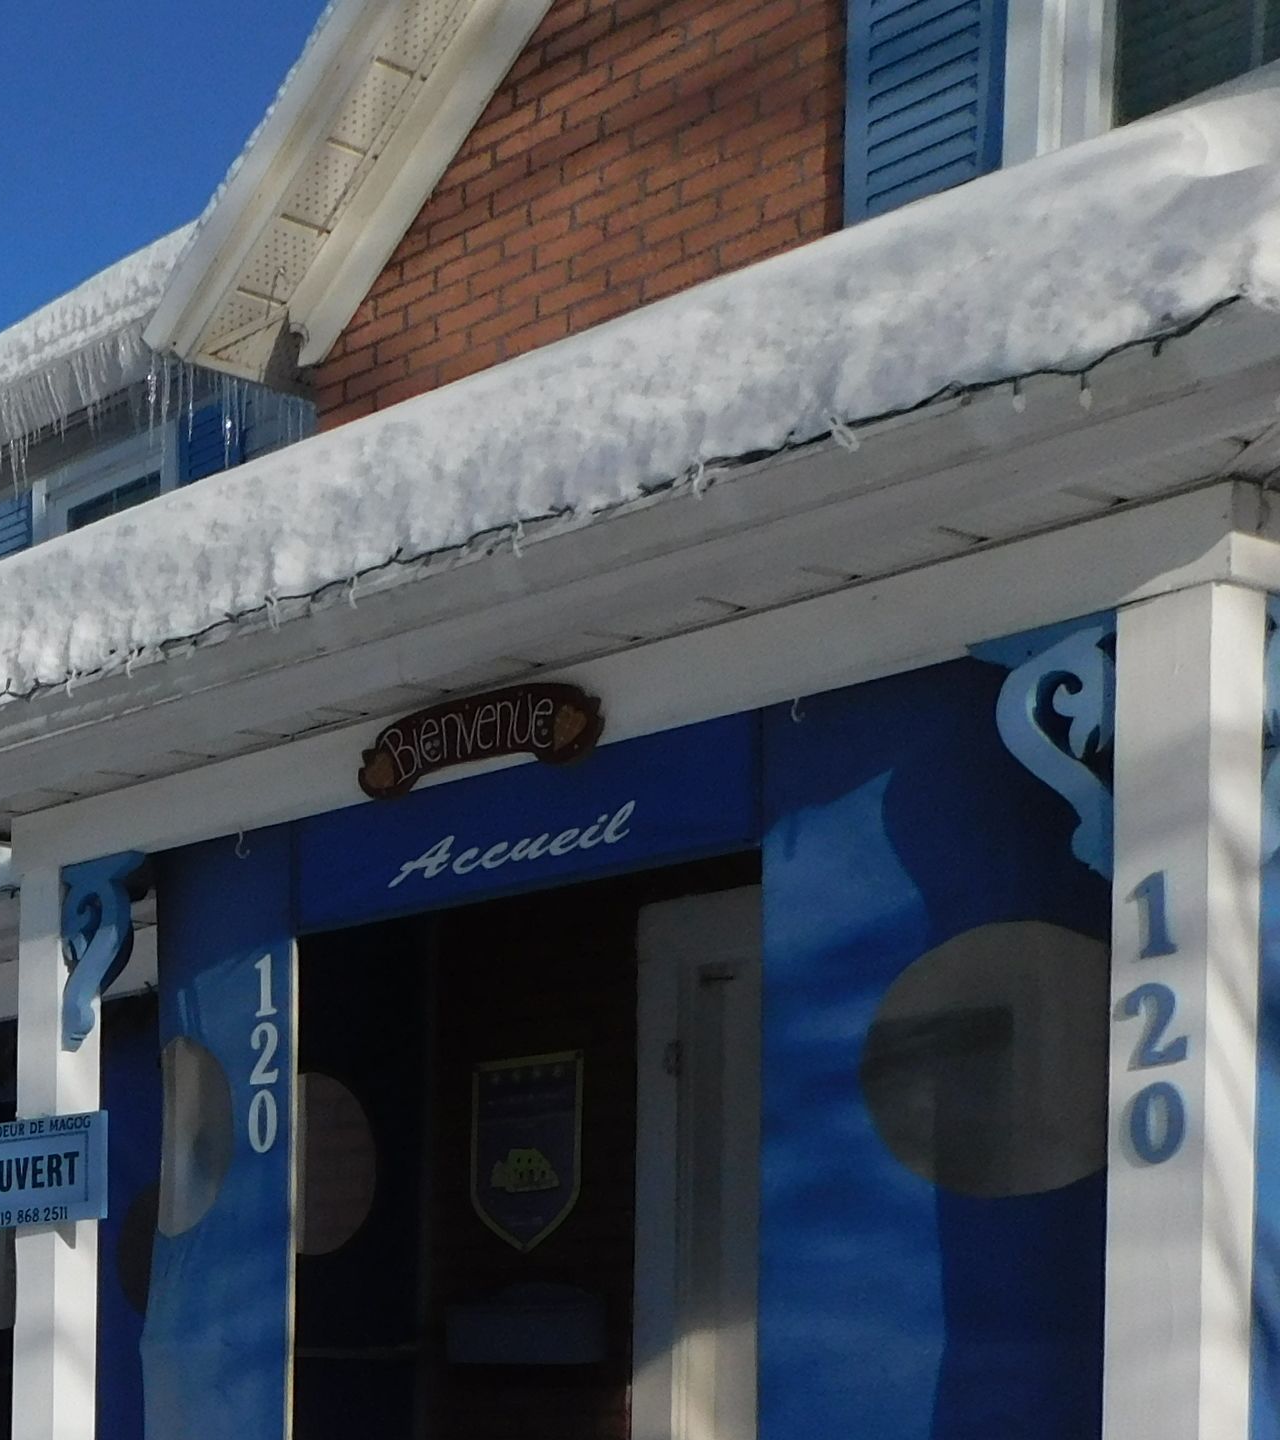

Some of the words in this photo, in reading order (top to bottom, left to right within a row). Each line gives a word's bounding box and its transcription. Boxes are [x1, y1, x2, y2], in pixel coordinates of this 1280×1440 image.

[387, 800, 636, 889] Accueil
[248, 953, 279, 1154] 120
[1123, 870, 1189, 1165] 120
[29, 1120, 44, 1134] DE
[49, 1115, 91, 1132] MAGOG
[16, 1208, 40, 1224] 868
[43, 1206, 68, 1222] 2511
